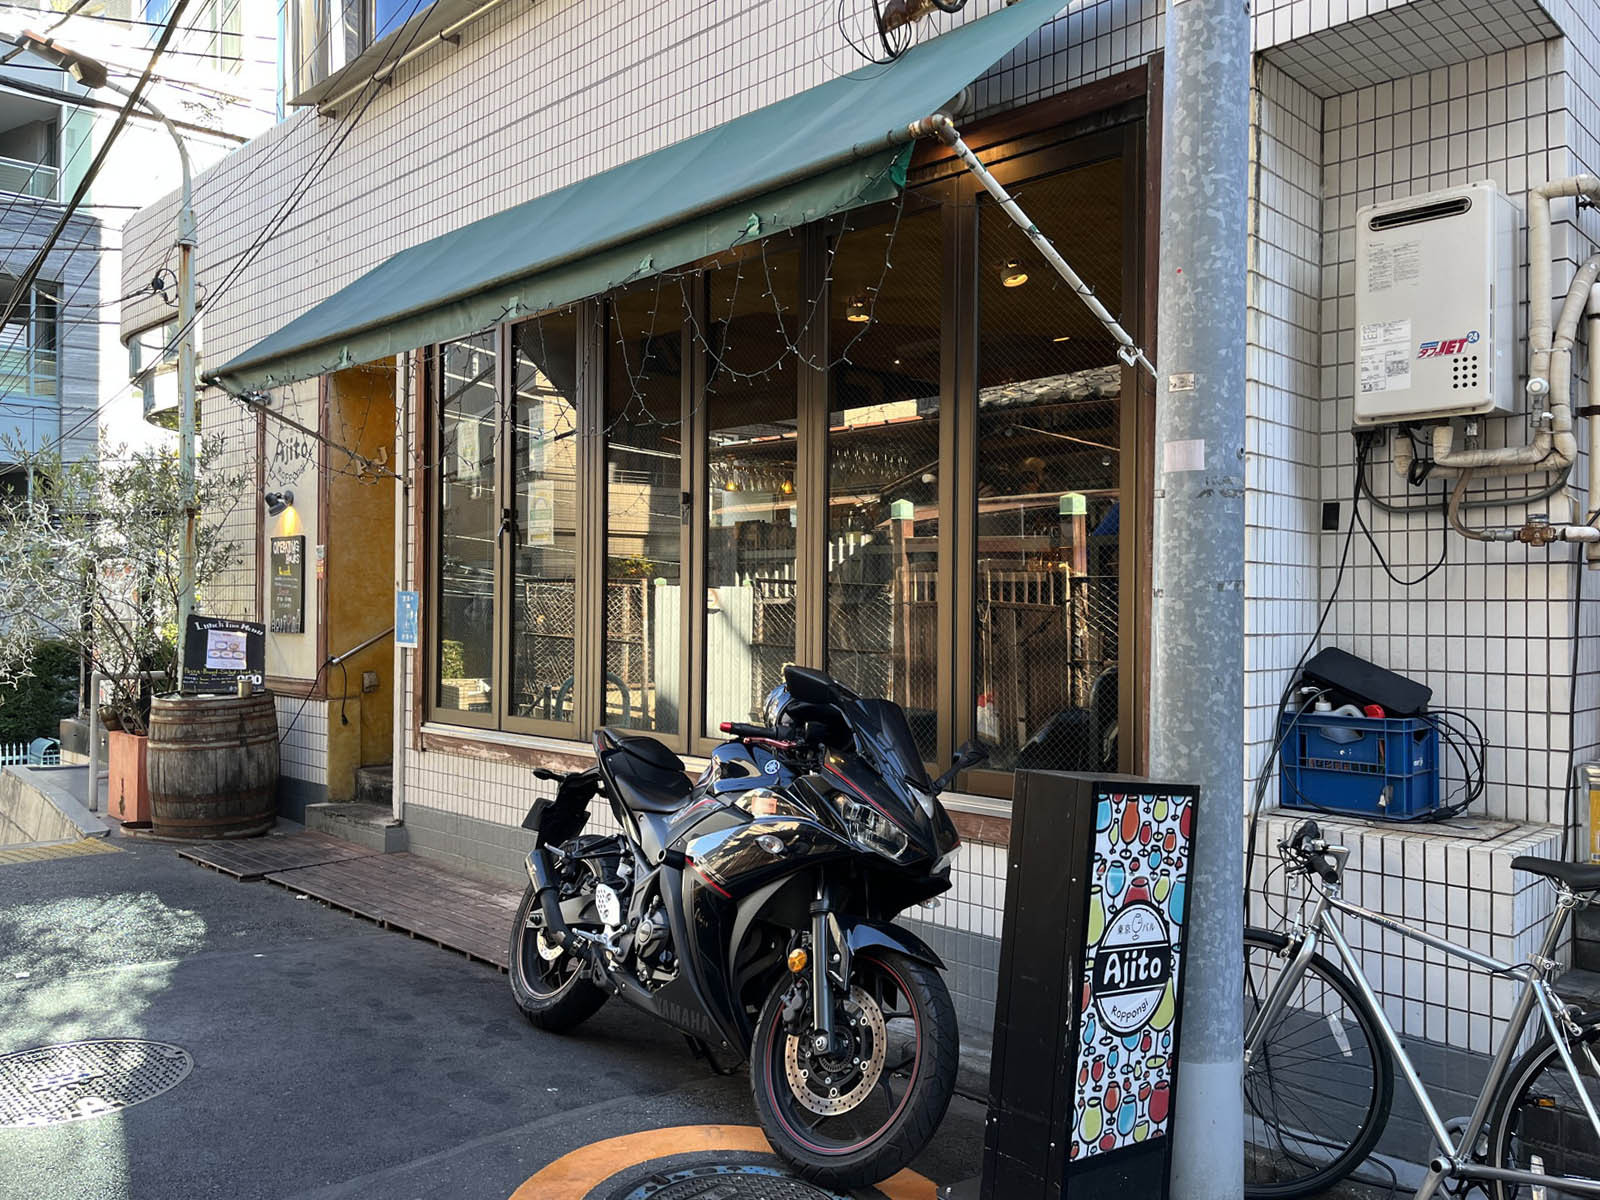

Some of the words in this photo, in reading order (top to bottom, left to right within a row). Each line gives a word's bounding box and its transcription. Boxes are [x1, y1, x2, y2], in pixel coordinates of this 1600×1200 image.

[275, 436, 308, 465] Ajito
[194, 620, 224, 631] Lunch
[1103, 950, 1161, 988] Ajito
[656, 992, 711, 1034] YAMAHA
[1111, 999, 1149, 1022] Roppongi
